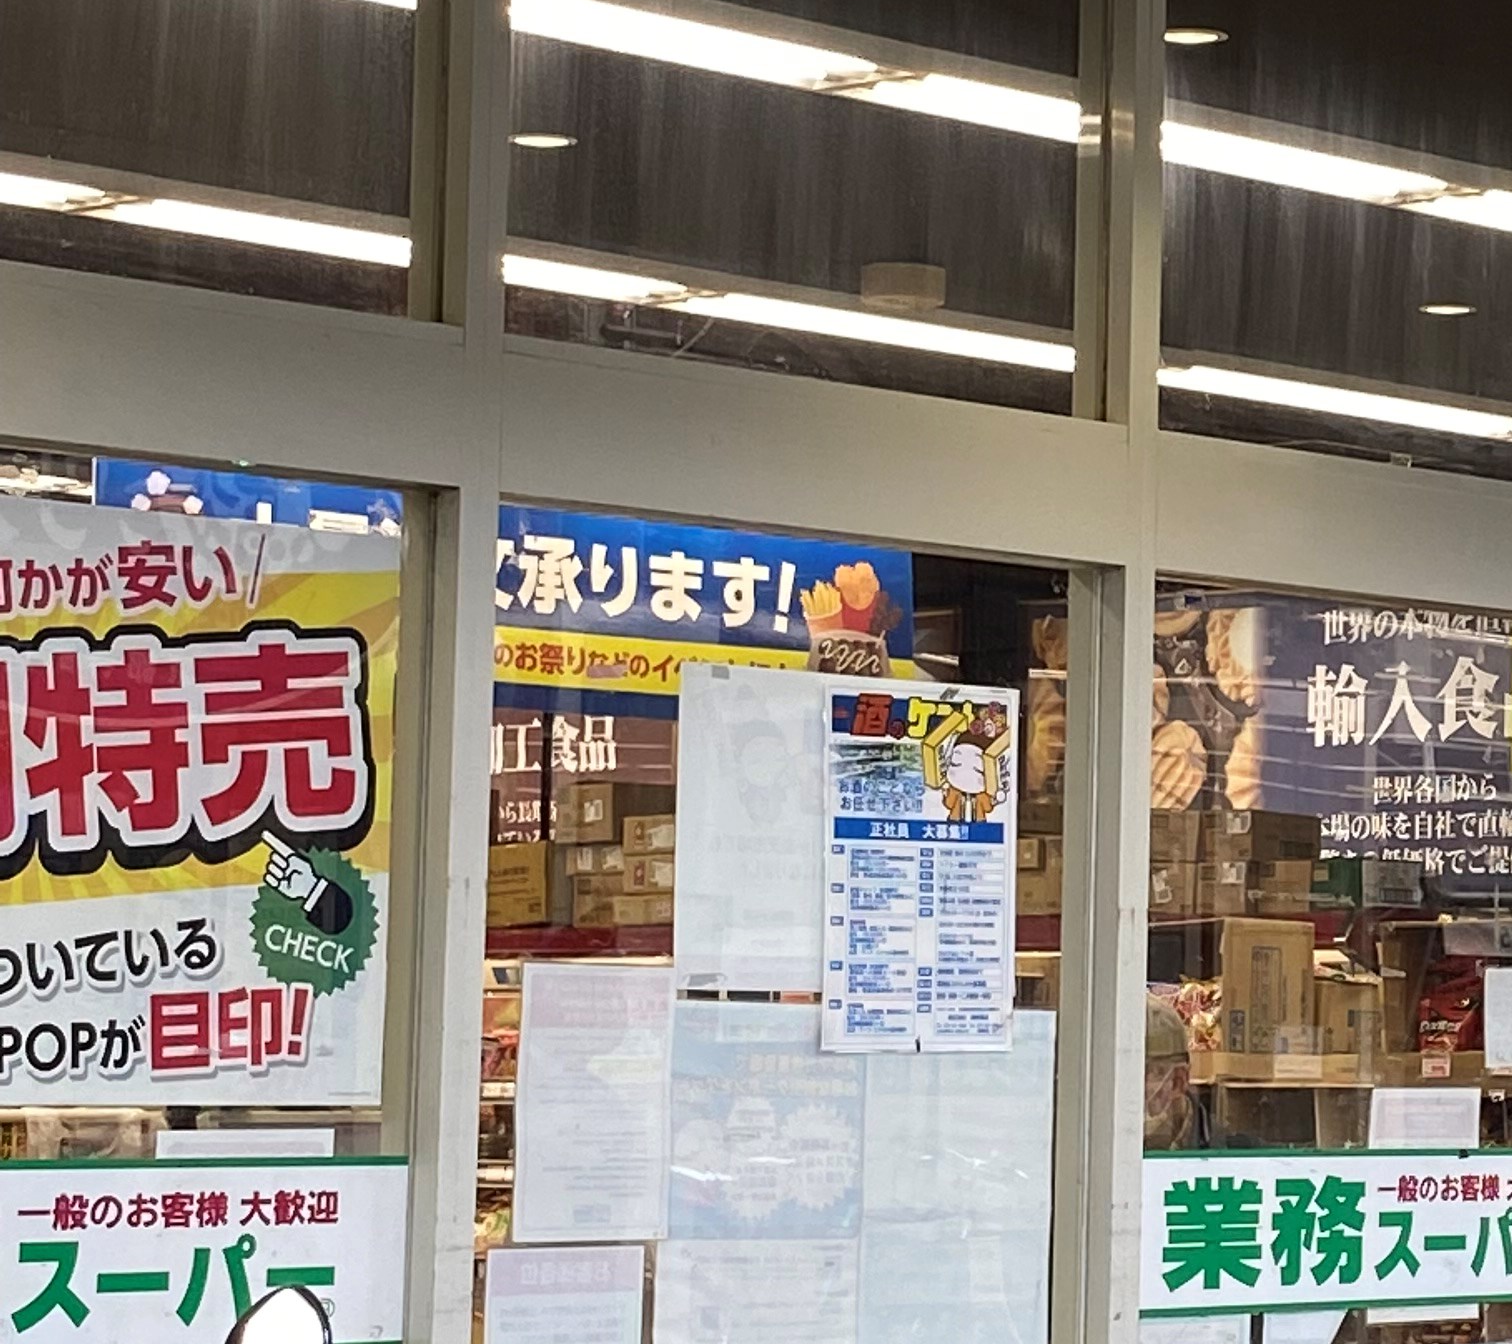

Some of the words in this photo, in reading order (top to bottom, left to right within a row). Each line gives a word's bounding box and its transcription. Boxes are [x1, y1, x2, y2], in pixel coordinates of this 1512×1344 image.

[493, 641, 682, 684] のお祭りなどのイ
[0, 642, 358, 846] 特売
[1371, 773, 1498, 806] 世界各国から
[262, 923, 355, 975] CHECK
[1377, 1174, 1500, 1203] 一般のお客様
[18, 1192, 229, 1231] 一般のお客様
[240, 1190, 340, 1228] 大歓迎
[11, 1233, 336, 1335] スーパー
